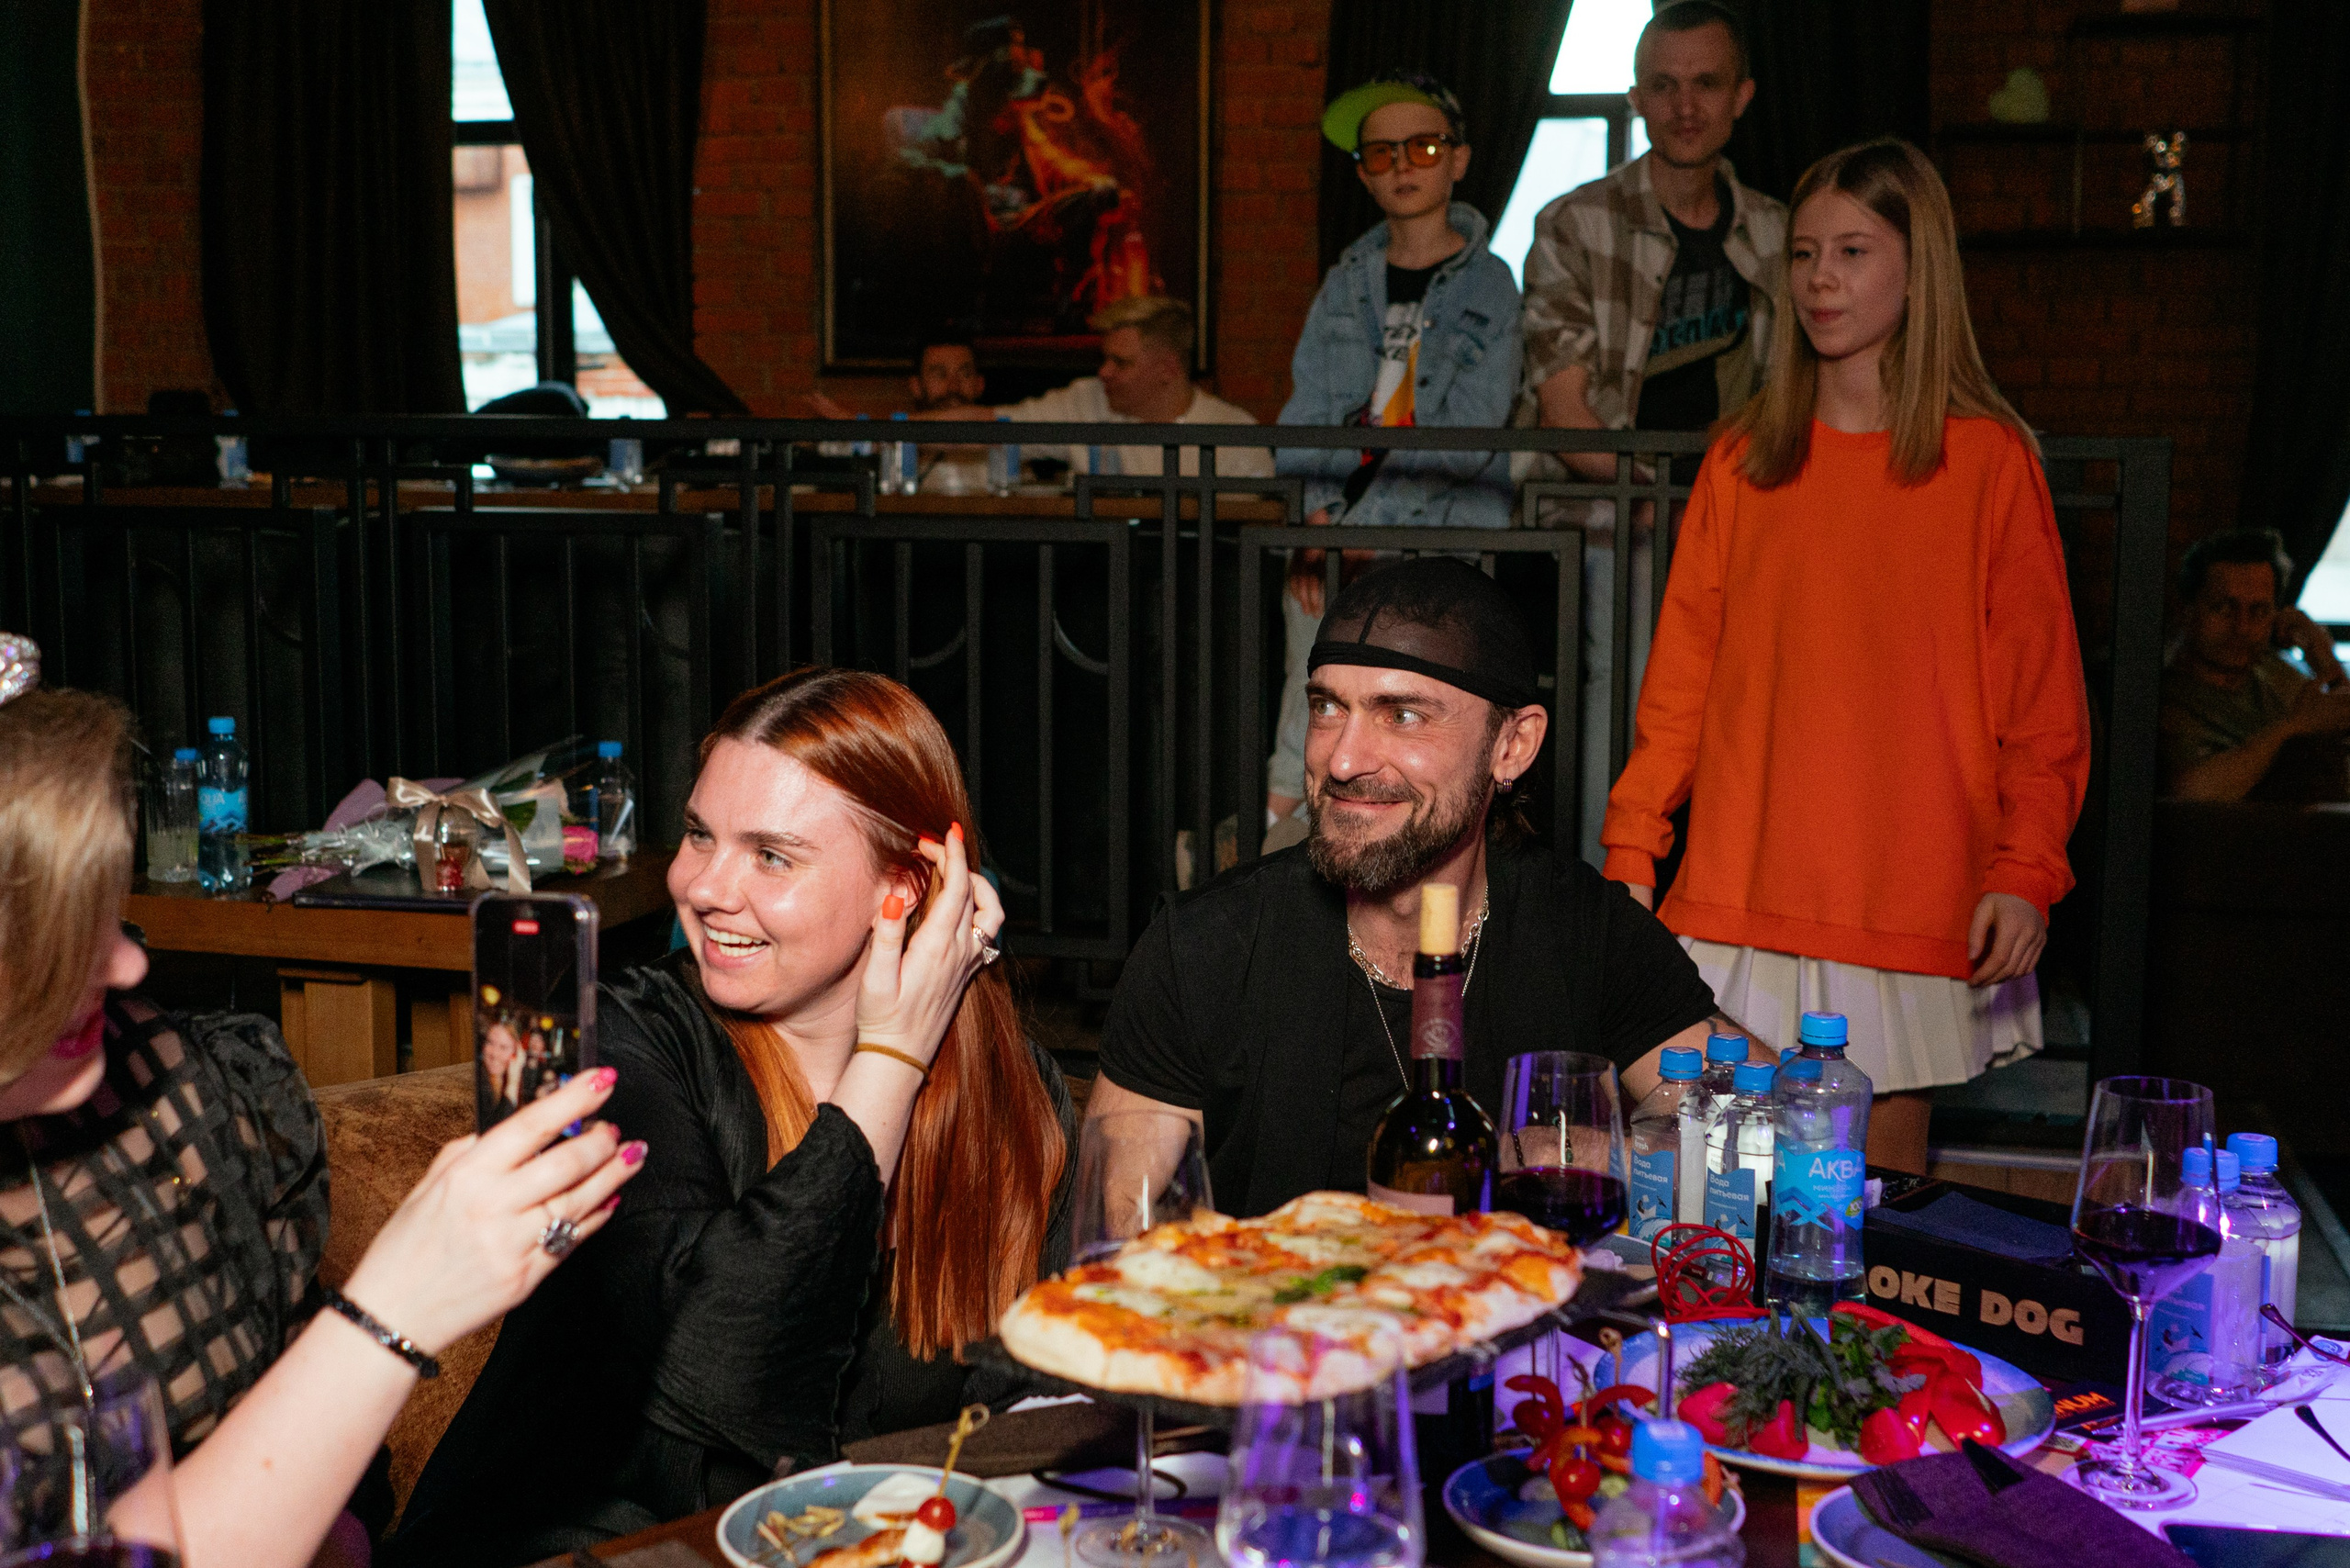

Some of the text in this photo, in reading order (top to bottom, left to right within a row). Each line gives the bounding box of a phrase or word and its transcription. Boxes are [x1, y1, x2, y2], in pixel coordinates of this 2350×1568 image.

[1634, 1155, 1651, 1169] Вода
[1633, 1168, 1669, 1183] питьевая
[1709, 1174, 1730, 1188] Вода
[1709, 1187, 1750, 1202] питьевая
[1867, 1264, 2085, 1347] OKE DOG
[2053, 1391, 2112, 1415] NUM
